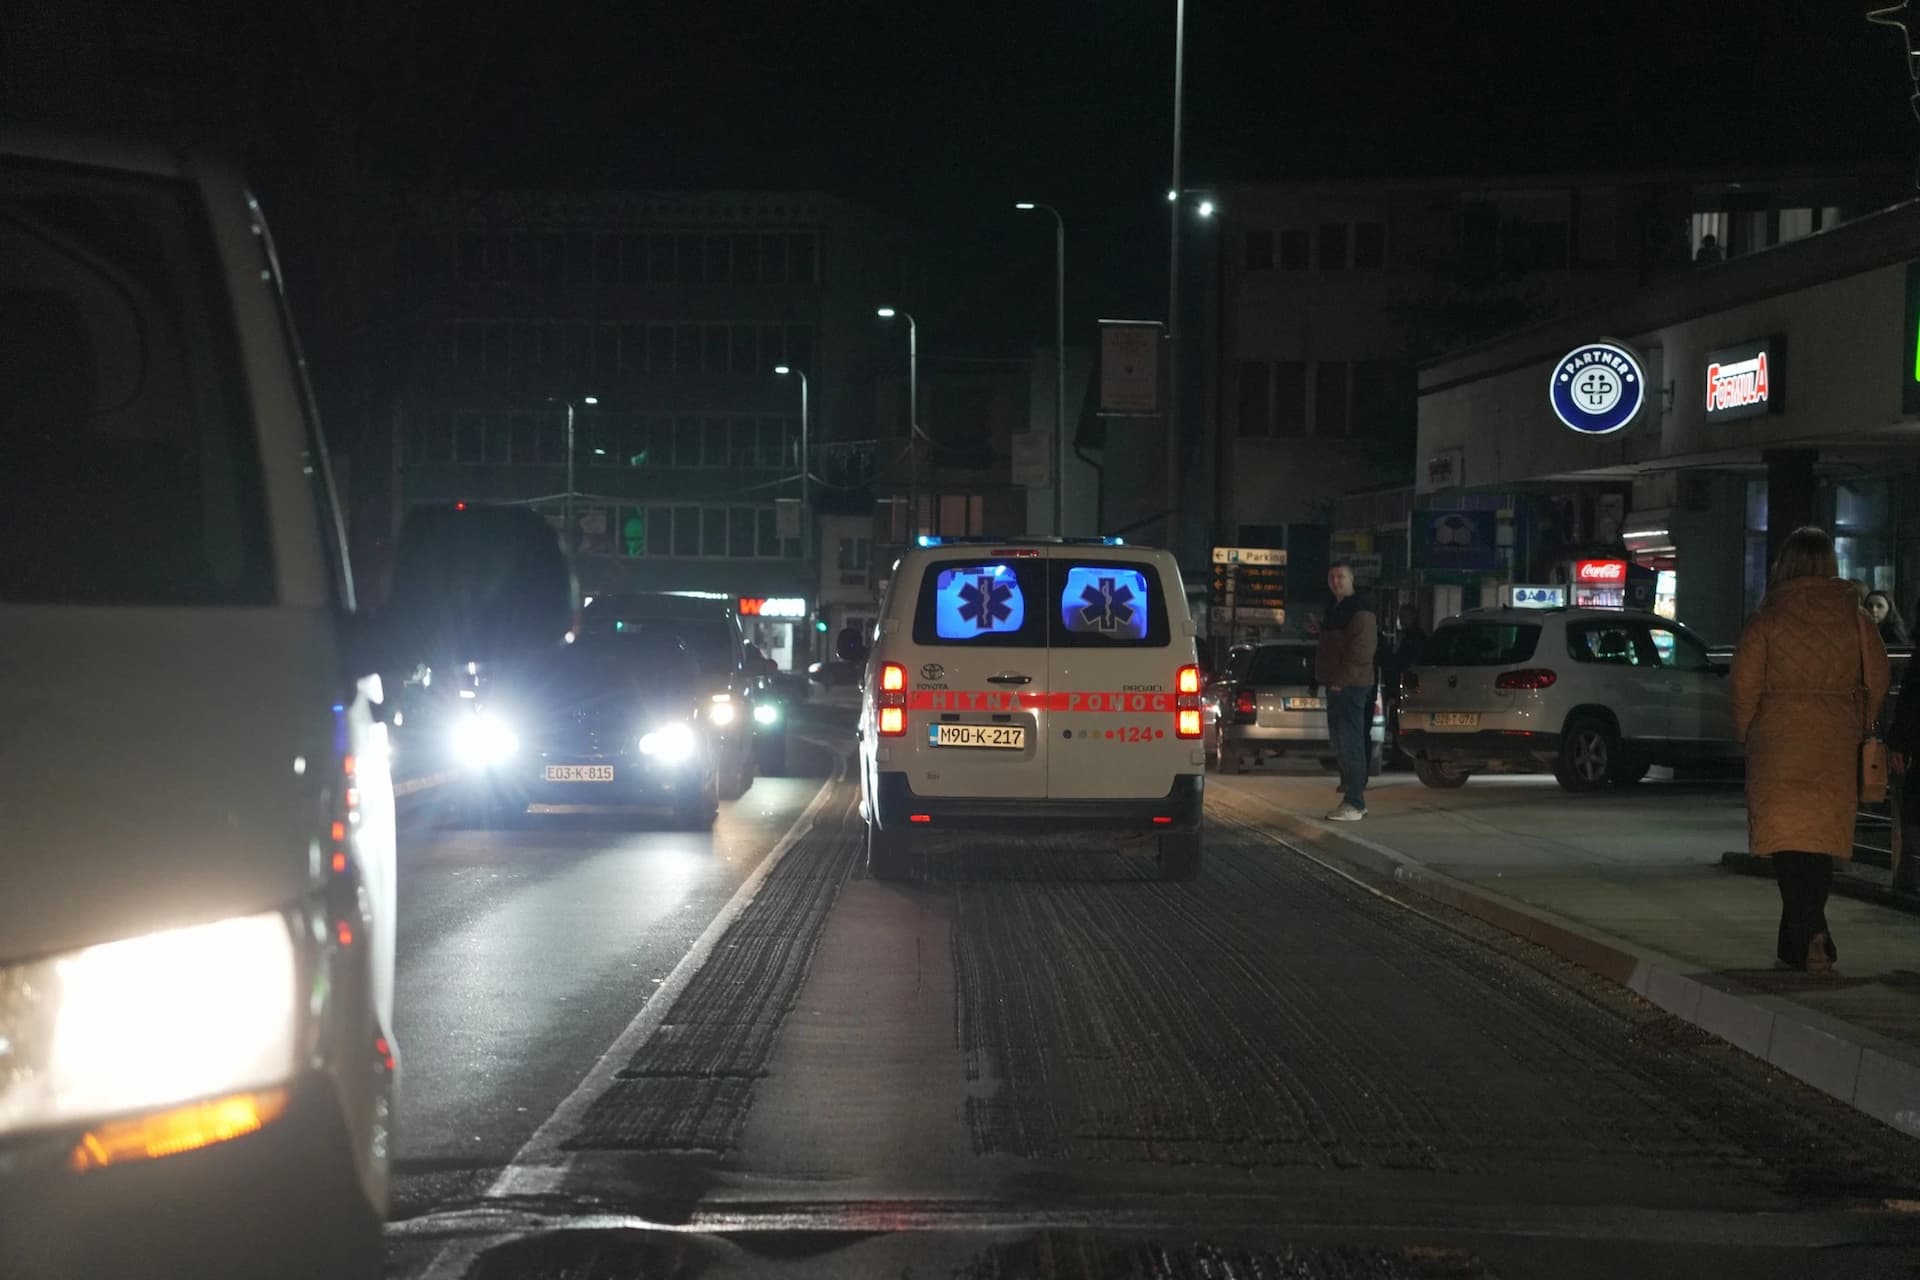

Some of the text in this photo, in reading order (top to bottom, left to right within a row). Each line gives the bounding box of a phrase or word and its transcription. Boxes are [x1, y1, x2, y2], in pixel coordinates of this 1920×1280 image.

[1566, 351, 1629, 375] PARTNER
[1246, 551, 1286, 564] Parking
[1581, 563, 1621, 578] Coca-Cola
[932, 693, 1167, 711] HITNA POMOC
[941, 728, 1022, 745] M90-K-217
[1116, 727, 1154, 743] 124
[547, 767, 612, 780] E03-K-815
